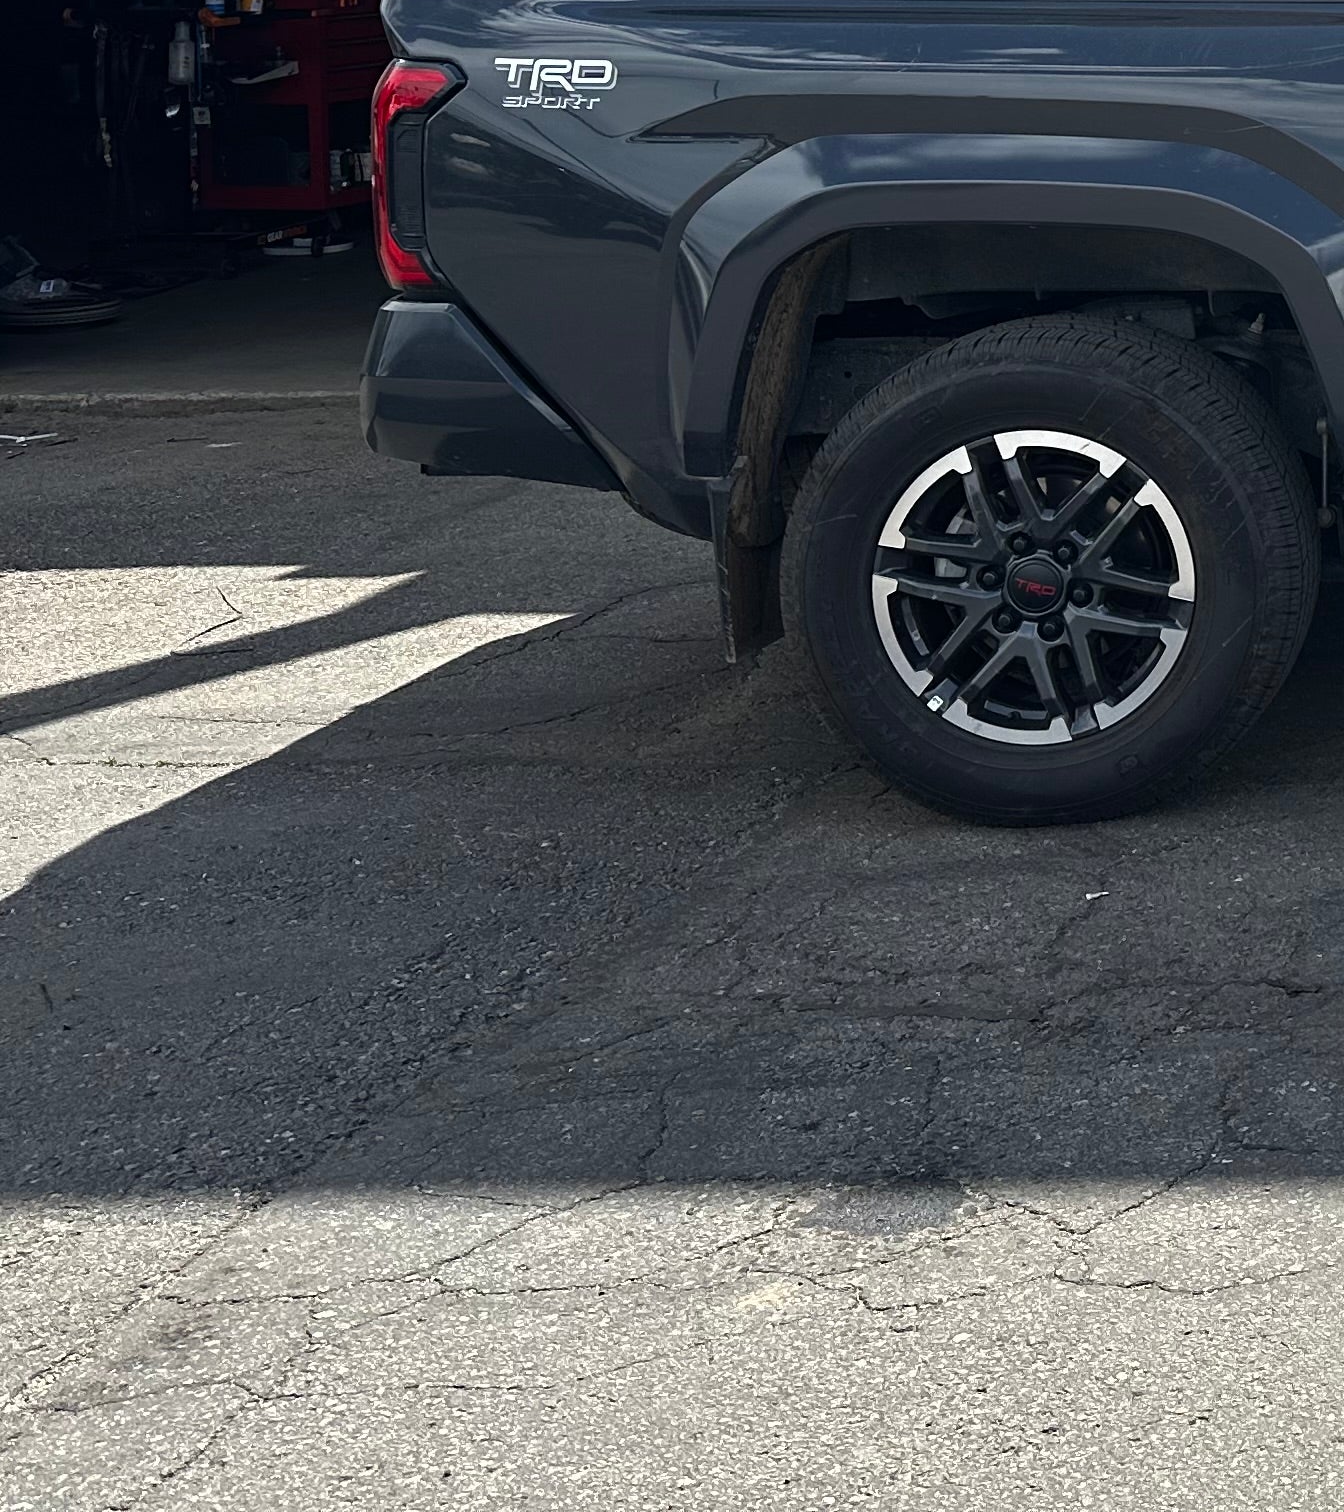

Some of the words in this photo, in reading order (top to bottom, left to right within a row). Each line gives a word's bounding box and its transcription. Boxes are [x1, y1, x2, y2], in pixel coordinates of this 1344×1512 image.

[494, 57, 617, 94] TRD
[502, 95, 600, 110] SPORT
[1015, 576, 1057, 597] TRD
